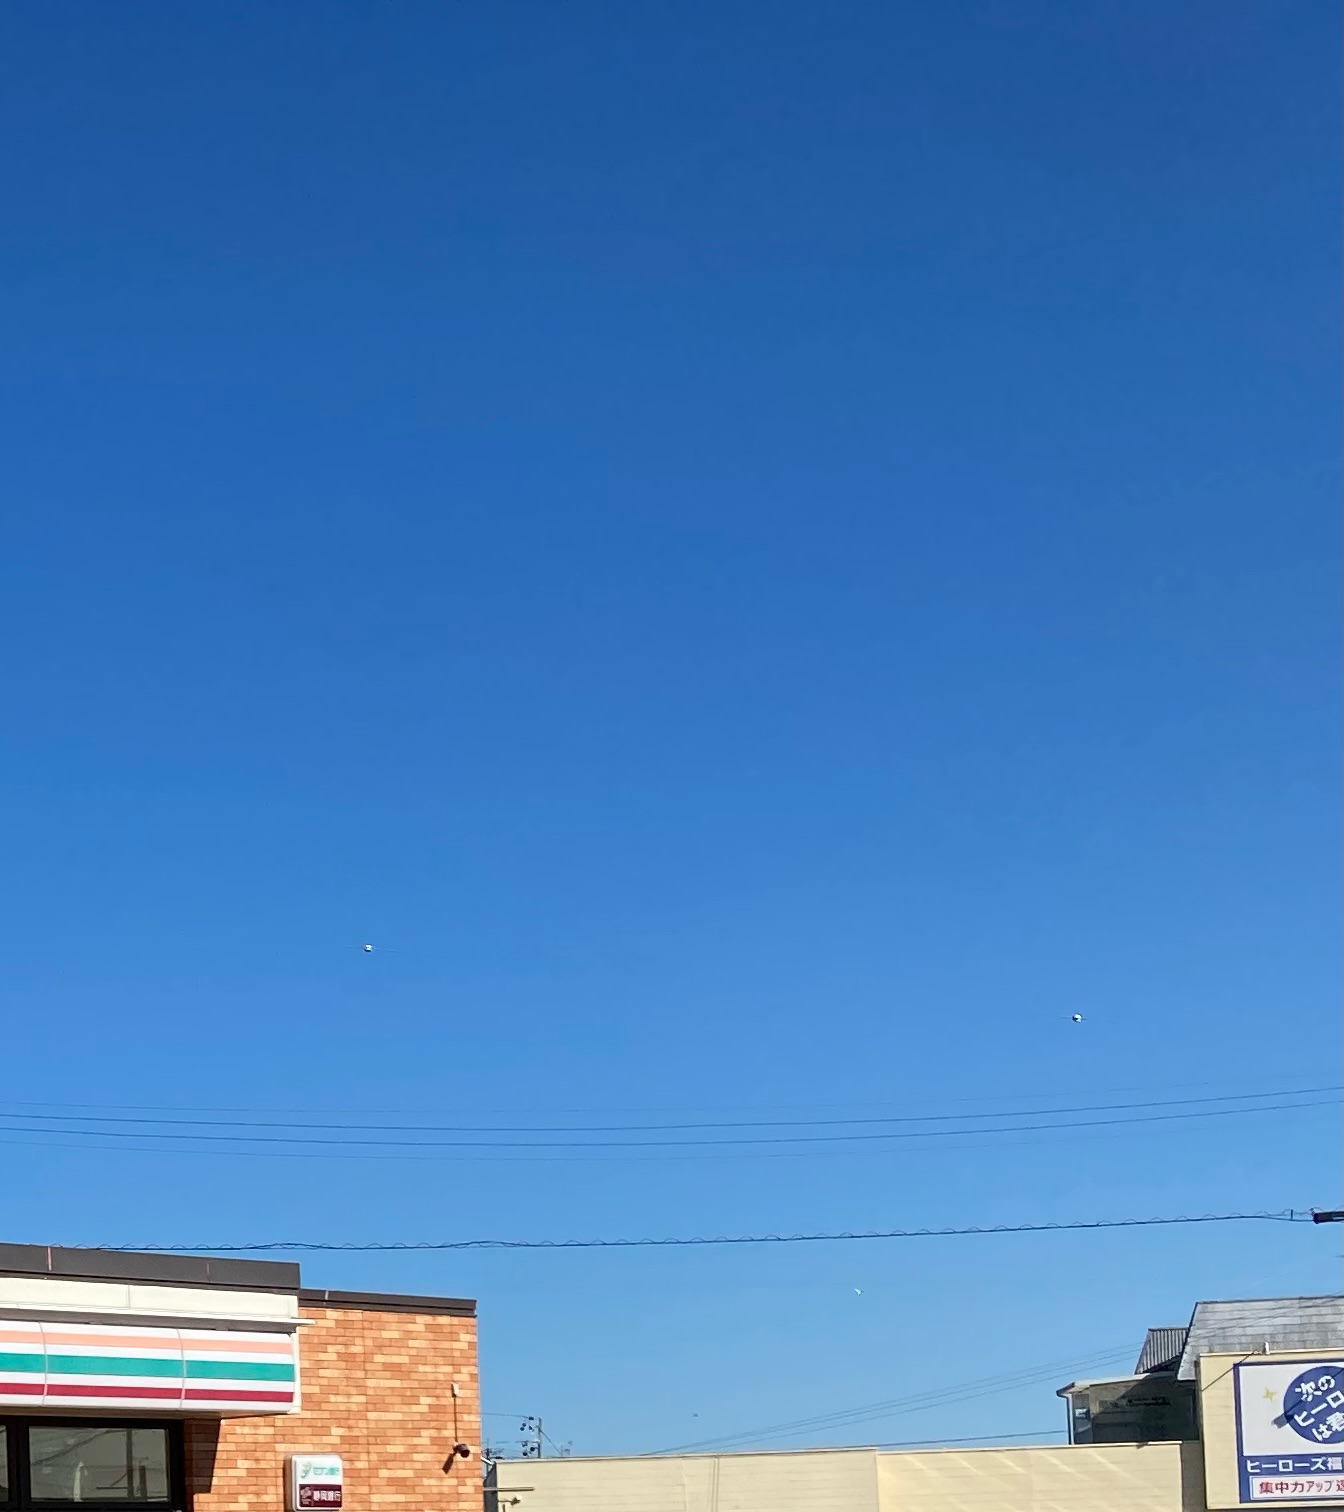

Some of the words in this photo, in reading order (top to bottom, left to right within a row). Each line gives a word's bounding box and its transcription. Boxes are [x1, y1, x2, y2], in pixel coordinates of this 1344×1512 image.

[1295, 1376, 1335, 1402] 次の
[1259, 1481, 1332, 1494] 集中力アップ
